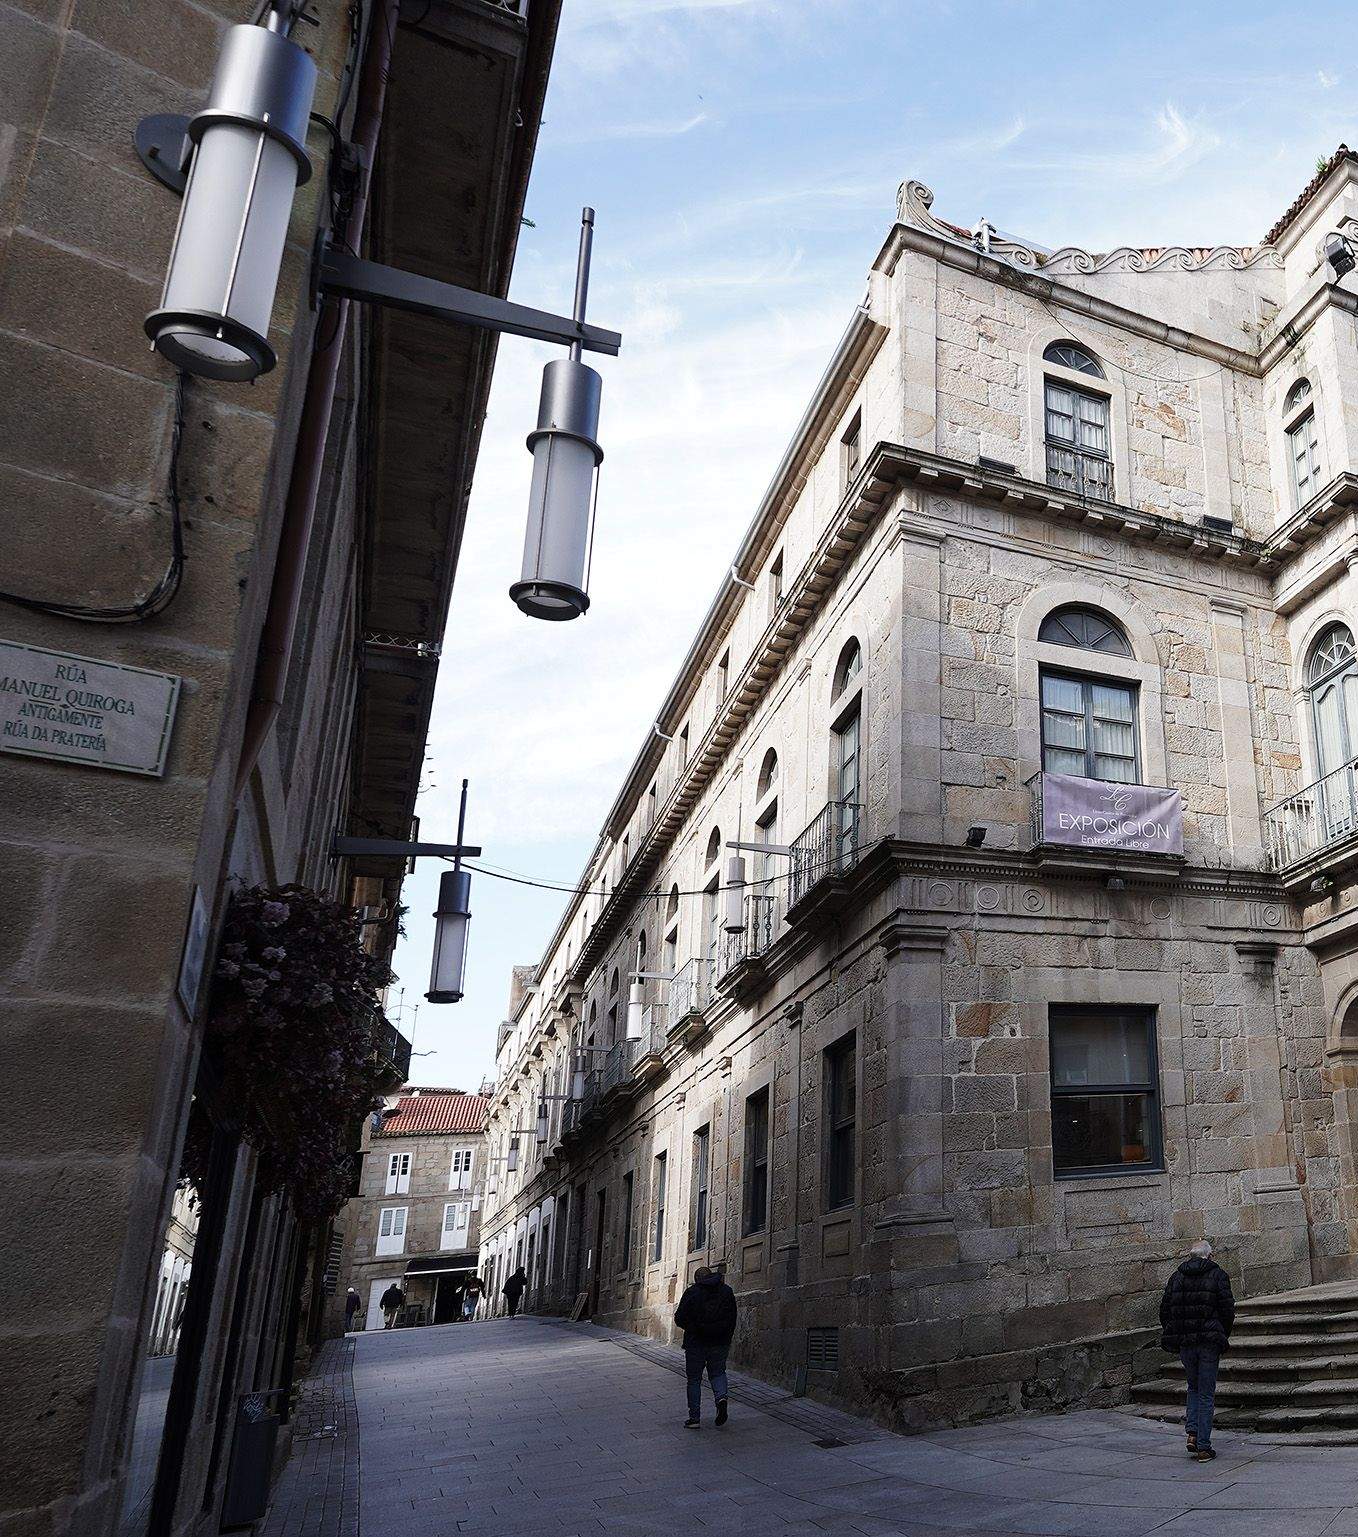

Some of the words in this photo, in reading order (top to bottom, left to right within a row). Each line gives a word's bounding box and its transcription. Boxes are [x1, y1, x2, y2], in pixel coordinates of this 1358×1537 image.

[55, 664, 88, 684] RÚA
[0, 676, 61, 701] MANUEL
[66, 689, 135, 715] QUIROGA
[18, 702, 104, 730] ANTIGAMENTE
[3, 719, 29, 739] RÚA
[31, 725, 48, 743] DA
[51, 729, 106, 751] PRATERÍA
[1059, 813, 1170, 840] EXPOSICIÓN
[1081, 834, 1123, 847] Entrada
[1125, 837, 1149, 849] Libre
